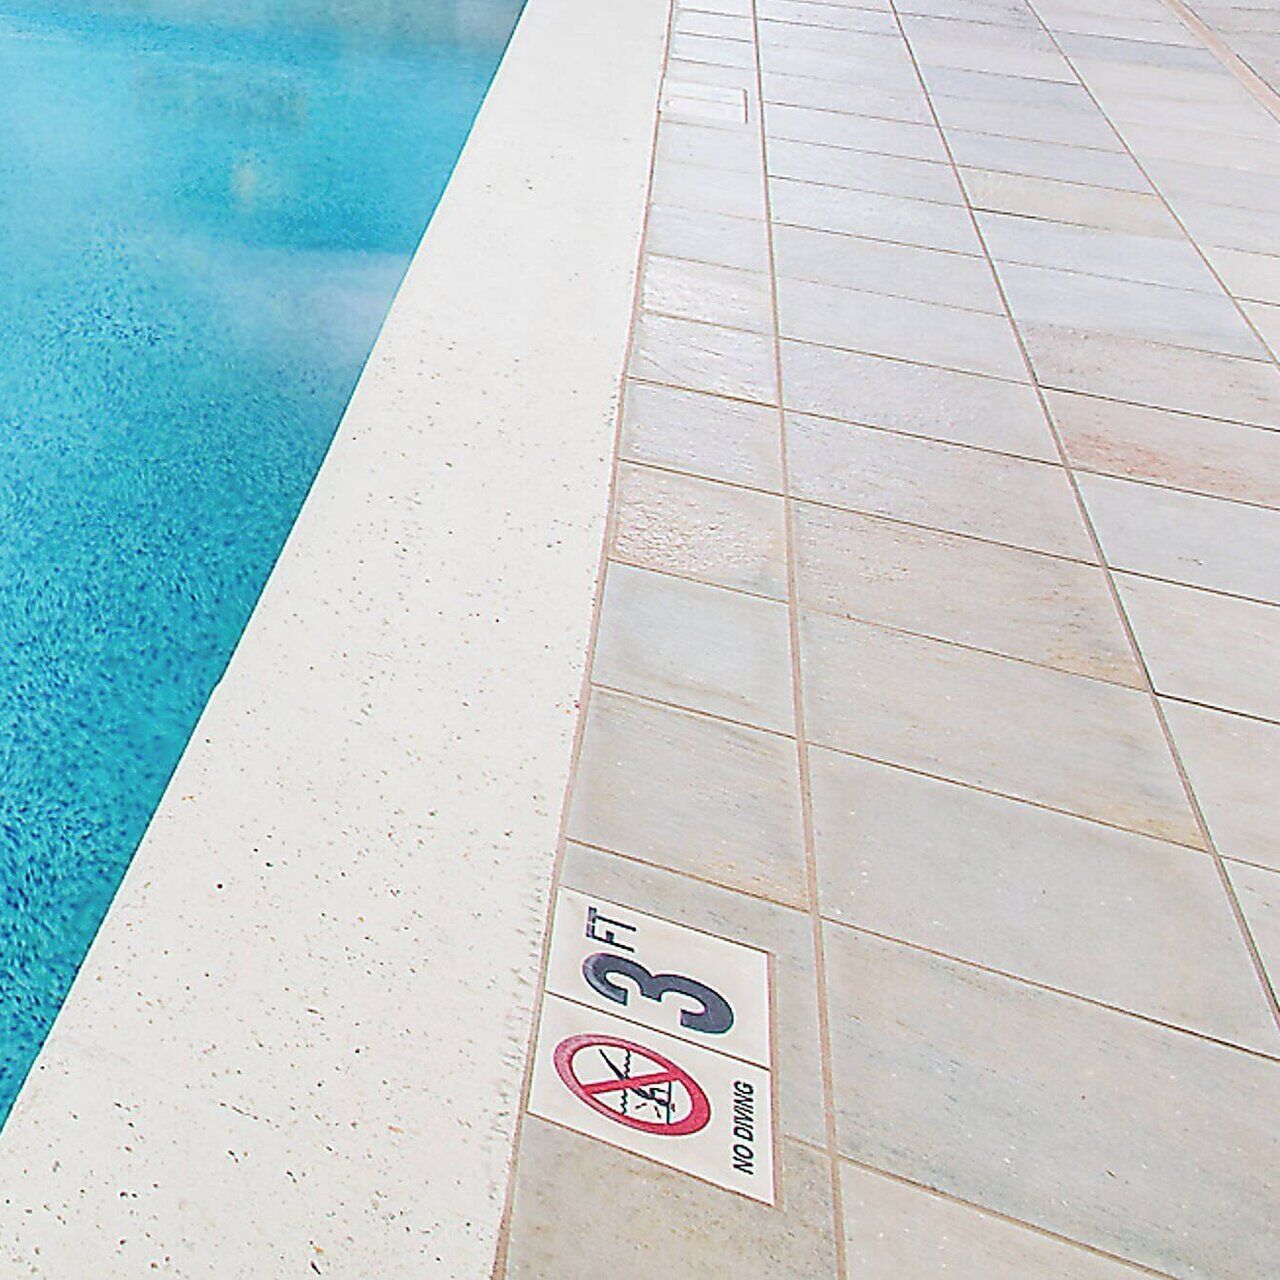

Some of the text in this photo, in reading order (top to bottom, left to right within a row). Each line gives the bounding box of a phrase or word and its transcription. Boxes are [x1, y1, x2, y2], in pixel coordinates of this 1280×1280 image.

[582, 906, 735, 1035] 3 FT
[733, 1080, 754, 1175] NO DIVING
